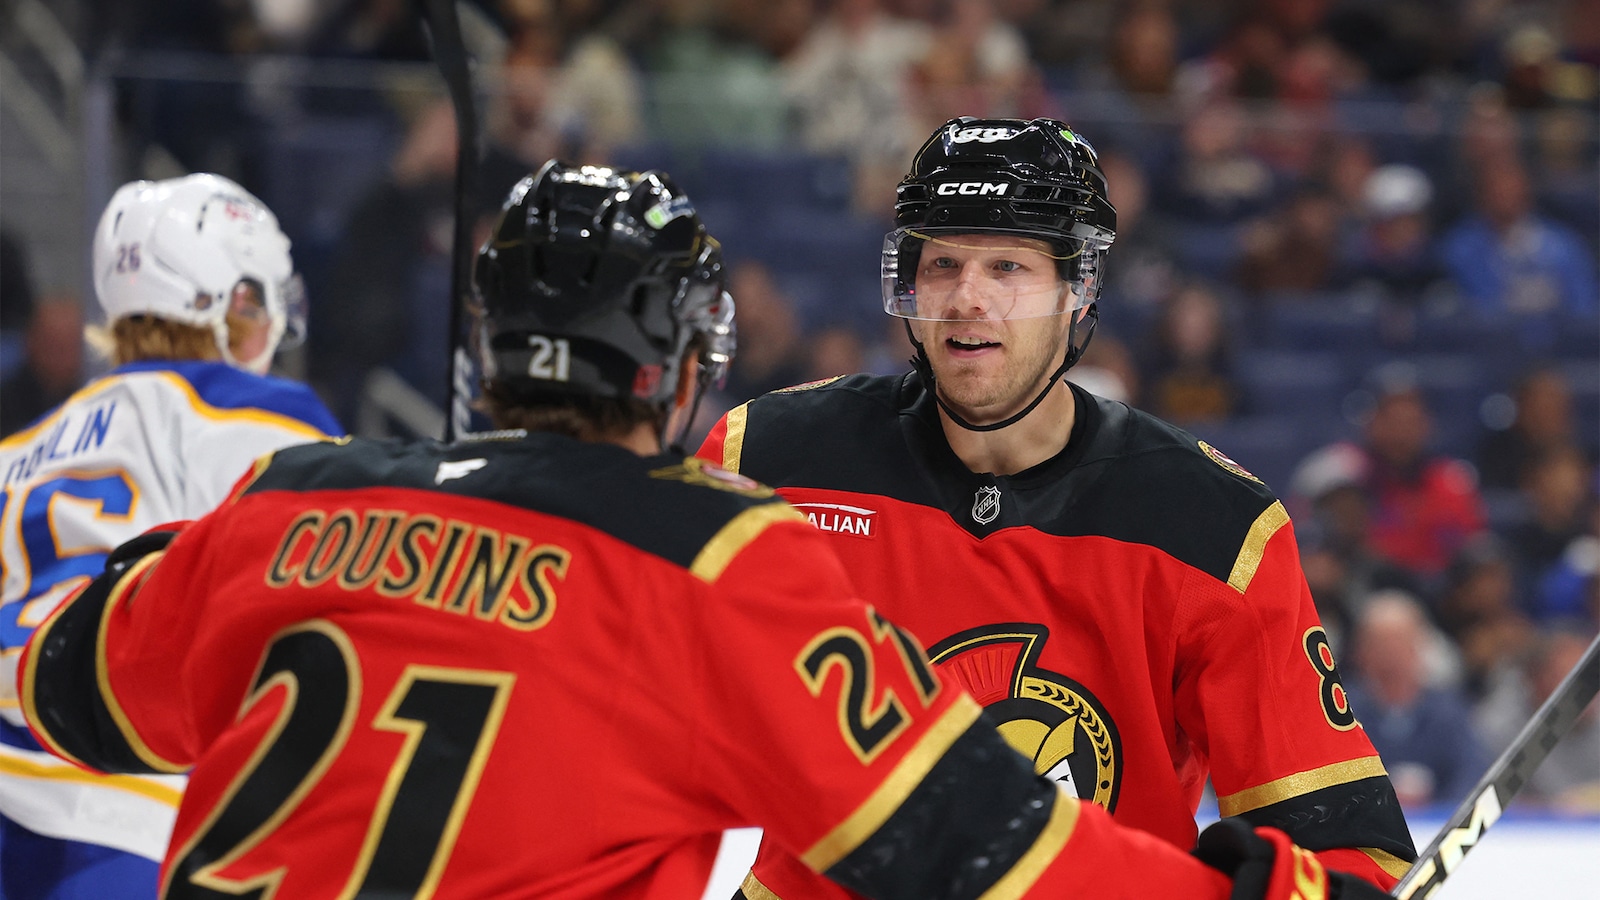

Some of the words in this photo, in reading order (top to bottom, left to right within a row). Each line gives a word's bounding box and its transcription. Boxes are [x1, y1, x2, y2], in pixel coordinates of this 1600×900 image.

[937, 183, 1009, 196] CCM
[116, 244, 141, 273] 26
[528, 335, 569, 381] 21
[796, 510, 872, 536] ALIAN
[977, 495, 995, 516] NHL
[265, 509, 572, 631] COUSINS
[792, 604, 943, 767] 21
[1302, 625, 1363, 732] 8
[159, 619, 517, 900] 21
